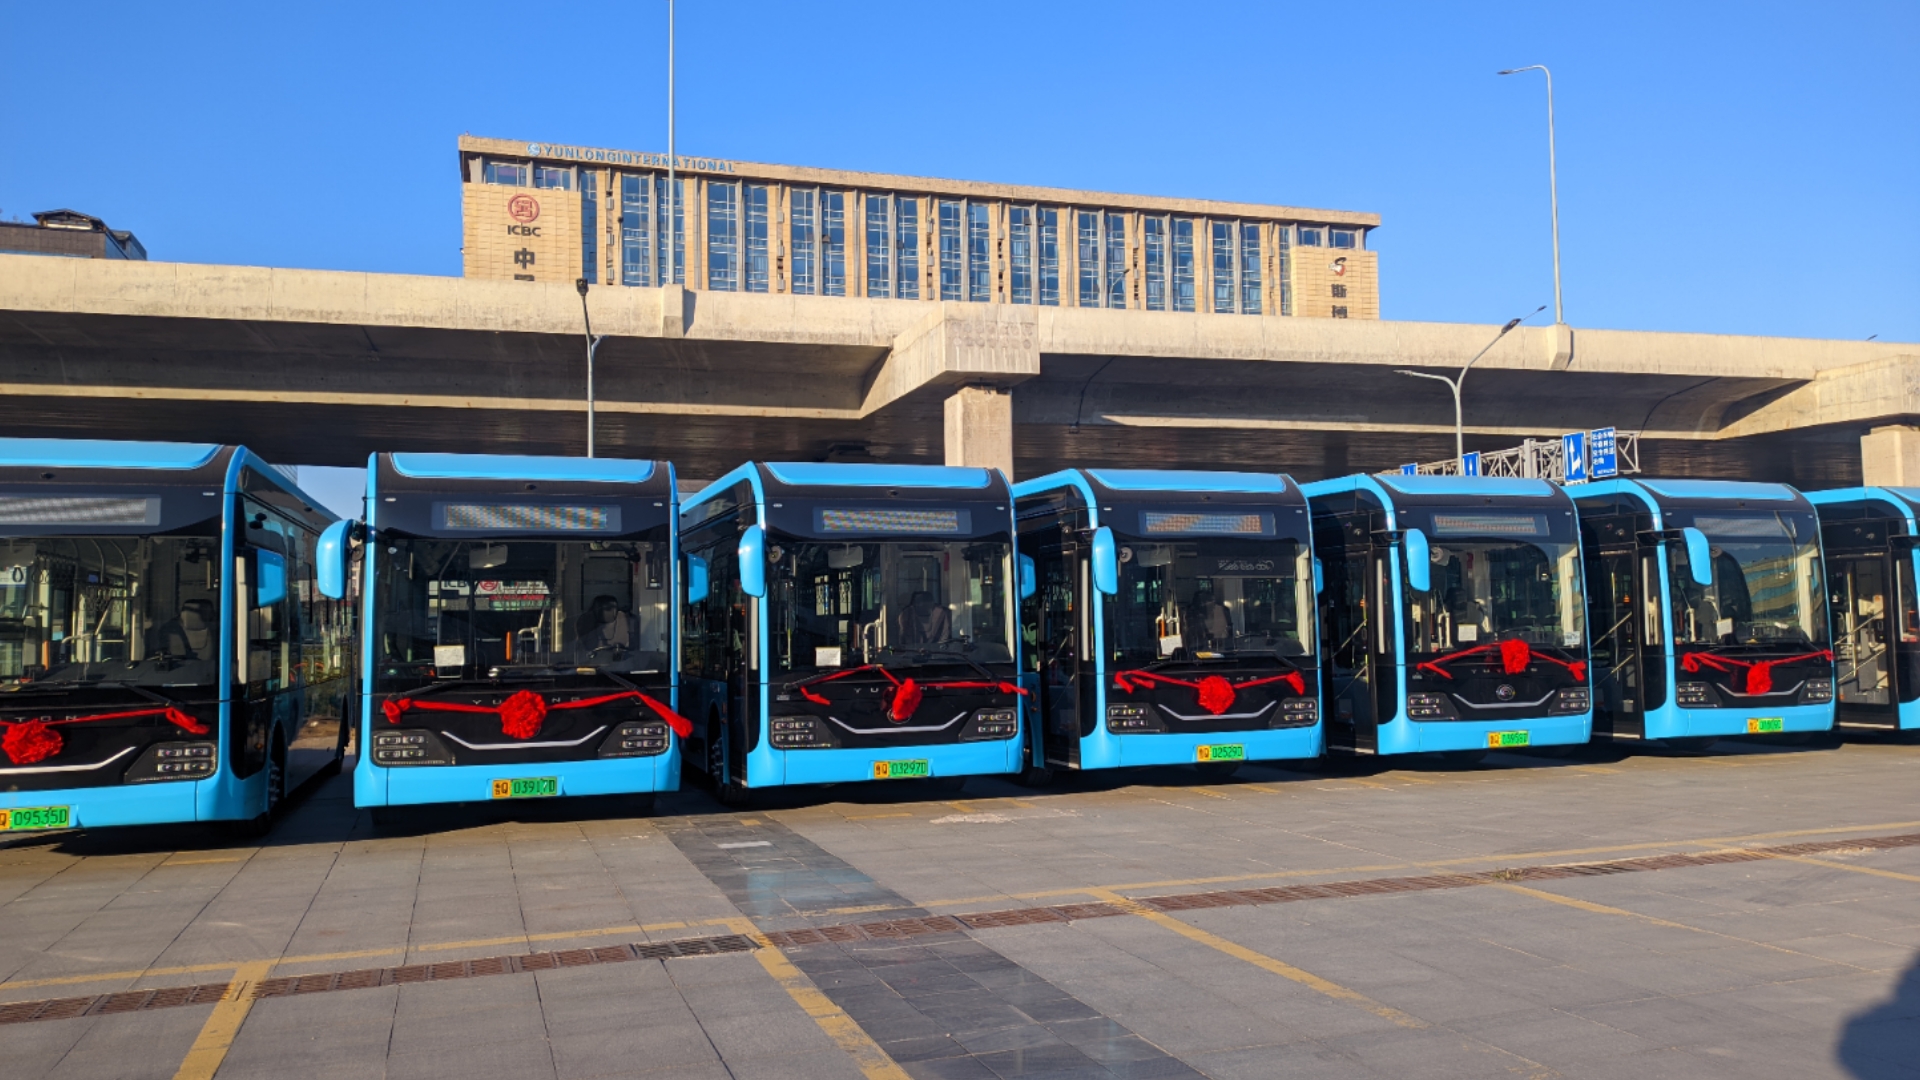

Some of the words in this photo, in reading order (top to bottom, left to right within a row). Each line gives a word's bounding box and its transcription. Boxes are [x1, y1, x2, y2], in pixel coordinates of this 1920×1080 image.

[507, 224, 542, 237] ICBC
[854, 686, 944, 694] YUTNG
[472, 696, 580, 706] YUNG
[891, 761, 926, 776] 03297D
[513, 779, 555, 794] 03917D
[14, 808, 67, 826] 09535D
